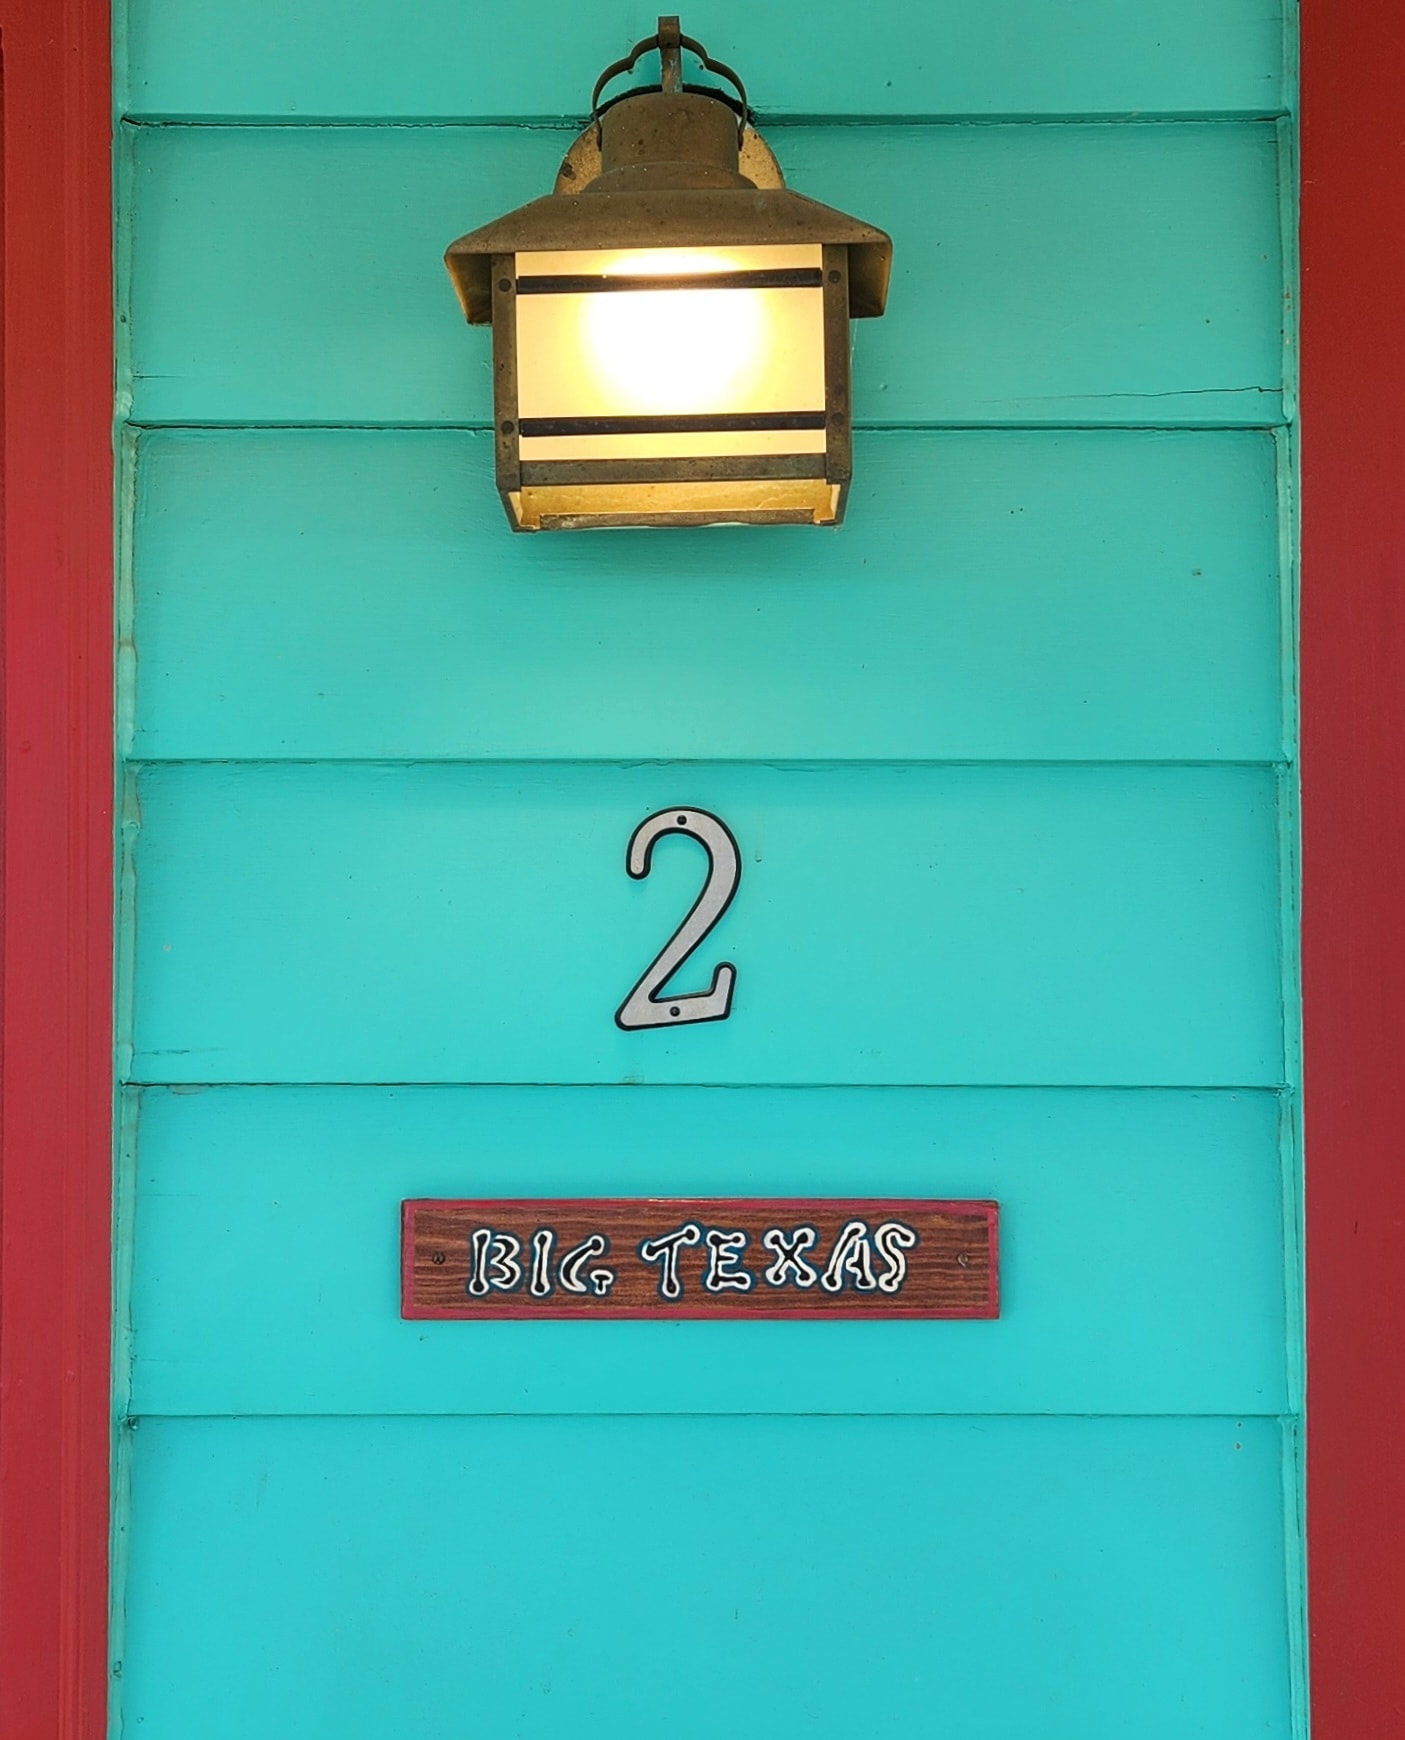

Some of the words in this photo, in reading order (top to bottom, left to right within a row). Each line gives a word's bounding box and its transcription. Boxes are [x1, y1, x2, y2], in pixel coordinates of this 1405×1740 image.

[615, 806, 742, 1031] 2
[469, 1228, 613, 1296] BIG
[642, 1222, 915, 1297] TEXAS
